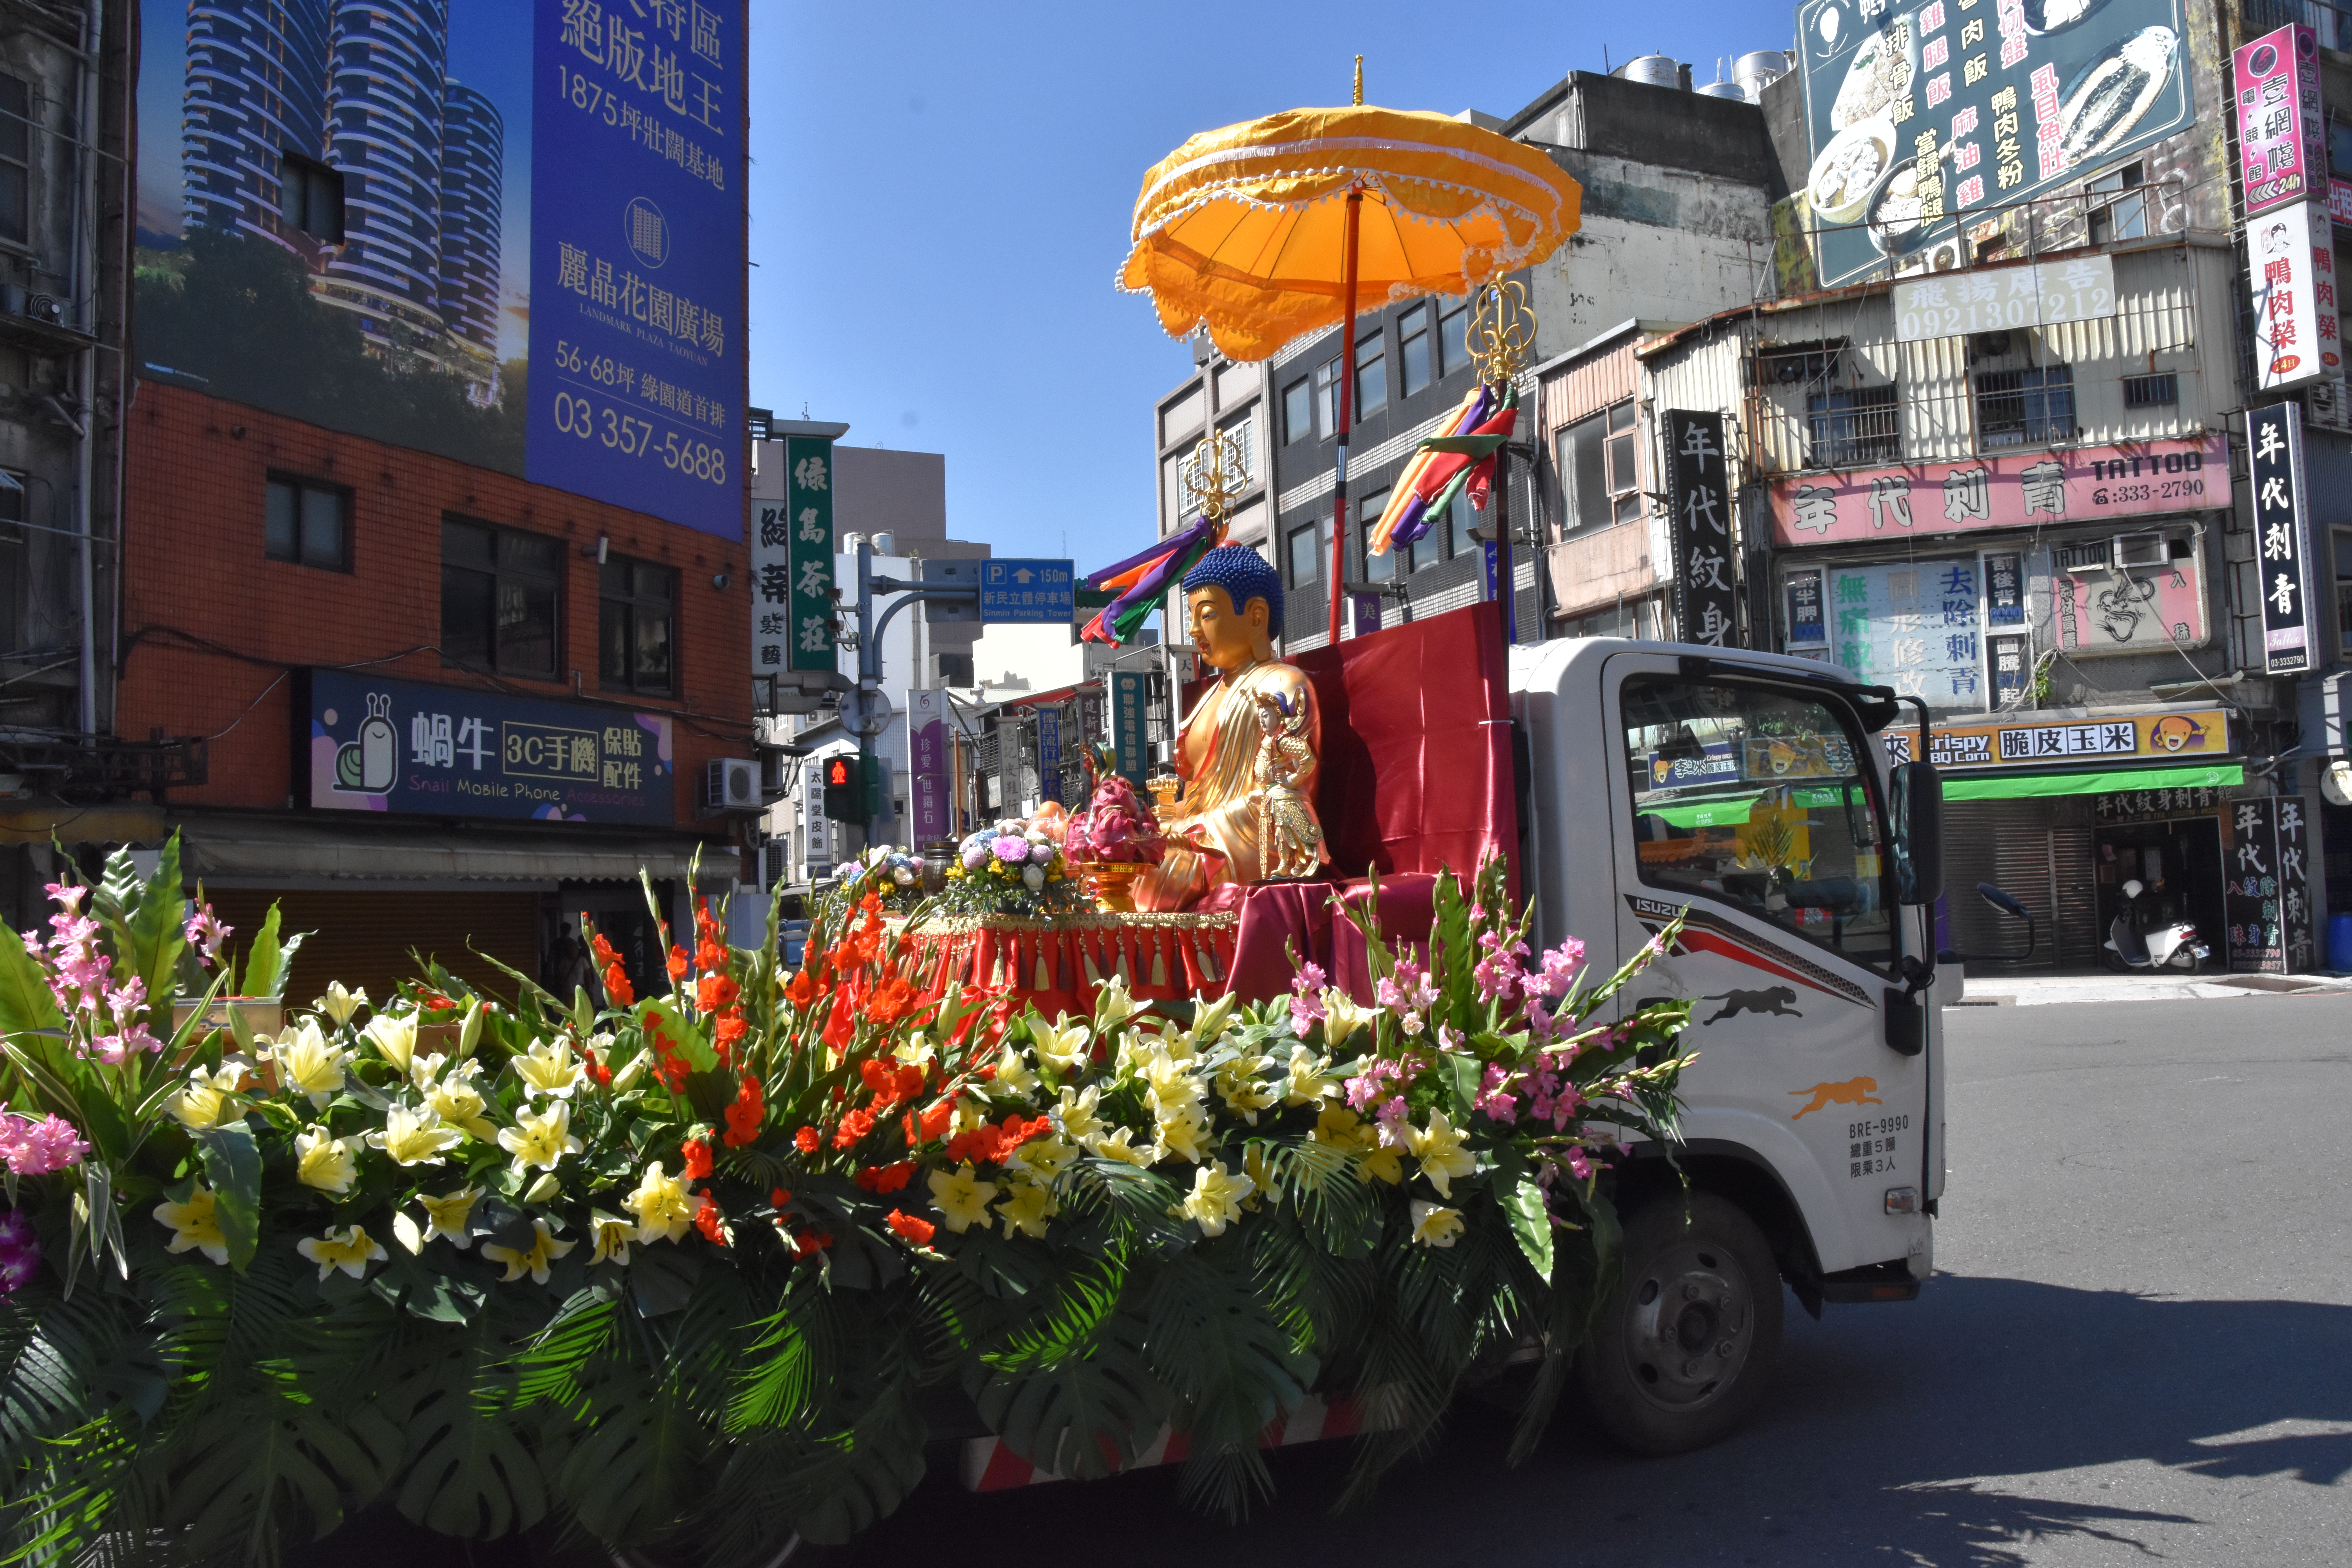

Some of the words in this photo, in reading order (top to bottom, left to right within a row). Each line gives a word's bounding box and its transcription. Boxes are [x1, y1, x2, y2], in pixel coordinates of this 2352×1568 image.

[630, 0, 723, 70] 特區
[1919, 2, 1952, 109] 雞腿飯
[560, 0, 724, 136] 絕版地王
[1885, 23, 1915, 127] 排骨飯
[559, 65, 724, 191] 1875坪壯闊基地
[1991, 86, 2024, 191] 鴨肉冬粉
[2031, 63, 2068, 180] 虱目魚肚
[2241, 87, 2263, 182] 電競館
[1915, 128, 1944, 228] 當歸鴨腿
[1952, 106, 1984, 209] 麻油雞
[2279, 176, 2300, 194] 24h
[558, 241, 724, 357] 麗晶花園廣場
[1902, 287, 2111, 339] 0921307212
[1907, 265, 2103, 310] 飛揚廣告
[2264, 256, 2297, 351] 鴨肉榮
[2313, 246, 2337, 340] 鴨肉榮
[580, 303, 632, 334] LANDMARK
[637, 328, 664, 348] PLAZA
[669, 341, 707, 367] TAOYUAN
[2323, 354, 2337, 364] 24H
[2275, 359, 2296, 372] 24H
[641, 373, 725, 429] 綠園道首排
[555, 392, 592, 439] 03
[601, 408, 726, 485] 357-5688
[1794, 461, 2066, 534] 年代刺青
[2090, 451, 2202, 481] TATTOO
[2257, 423, 2296, 615] 年代刺青
[1680, 422, 1733, 647] 年代紋身
[2051, 541, 2107, 567] TATTOO
[984, 591, 1071, 606] 新民立體停車場
[1040, 569, 1068, 583] 150m
[1993, 556, 2014, 606] 割後背
[1014, 609, 1043, 618] Parking
[1361, 602, 1376, 620] 美
[1940, 566, 1979, 695] 去除刺青
[1990, 607, 2022, 620] 8000
[2058, 580, 2077, 649] 器材買賣
[1996, 638, 2020, 671] 圖騰
[2270, 633, 2301, 647] Tattoo
[2271, 655, 2304, 667] 03-3332790
[1997, 673, 2023, 686] 500
[2000, 688, 2020, 703] 起
[411, 711, 495, 771] 蝸牛
[507, 734, 596, 774] 3C手機
[604, 727, 642, 757] 保貼
[1123, 694, 1137, 771] 聯強電信聯盟
[1955, 751, 1990, 762] Corn
[2002, 724, 2132, 757] 脆皮玉米
[408, 775, 450, 793] Snail
[514, 783, 561, 801] Phone
[566, 787, 645, 808] Accessories
[603, 760, 642, 790] 配件
[2097, 786, 2232, 817] 年代紋身刺青館
[811, 771, 823, 849] 太陽堂皮飾
[2236, 805, 2266, 873] 年代
[1636, 899, 1681, 917] ISUZU
[2280, 802, 2312, 967] 年代刺青
[1850, 1115, 1908, 1138] BRE-9990
[1851, 1156, 1896, 1178] 限乘3人
